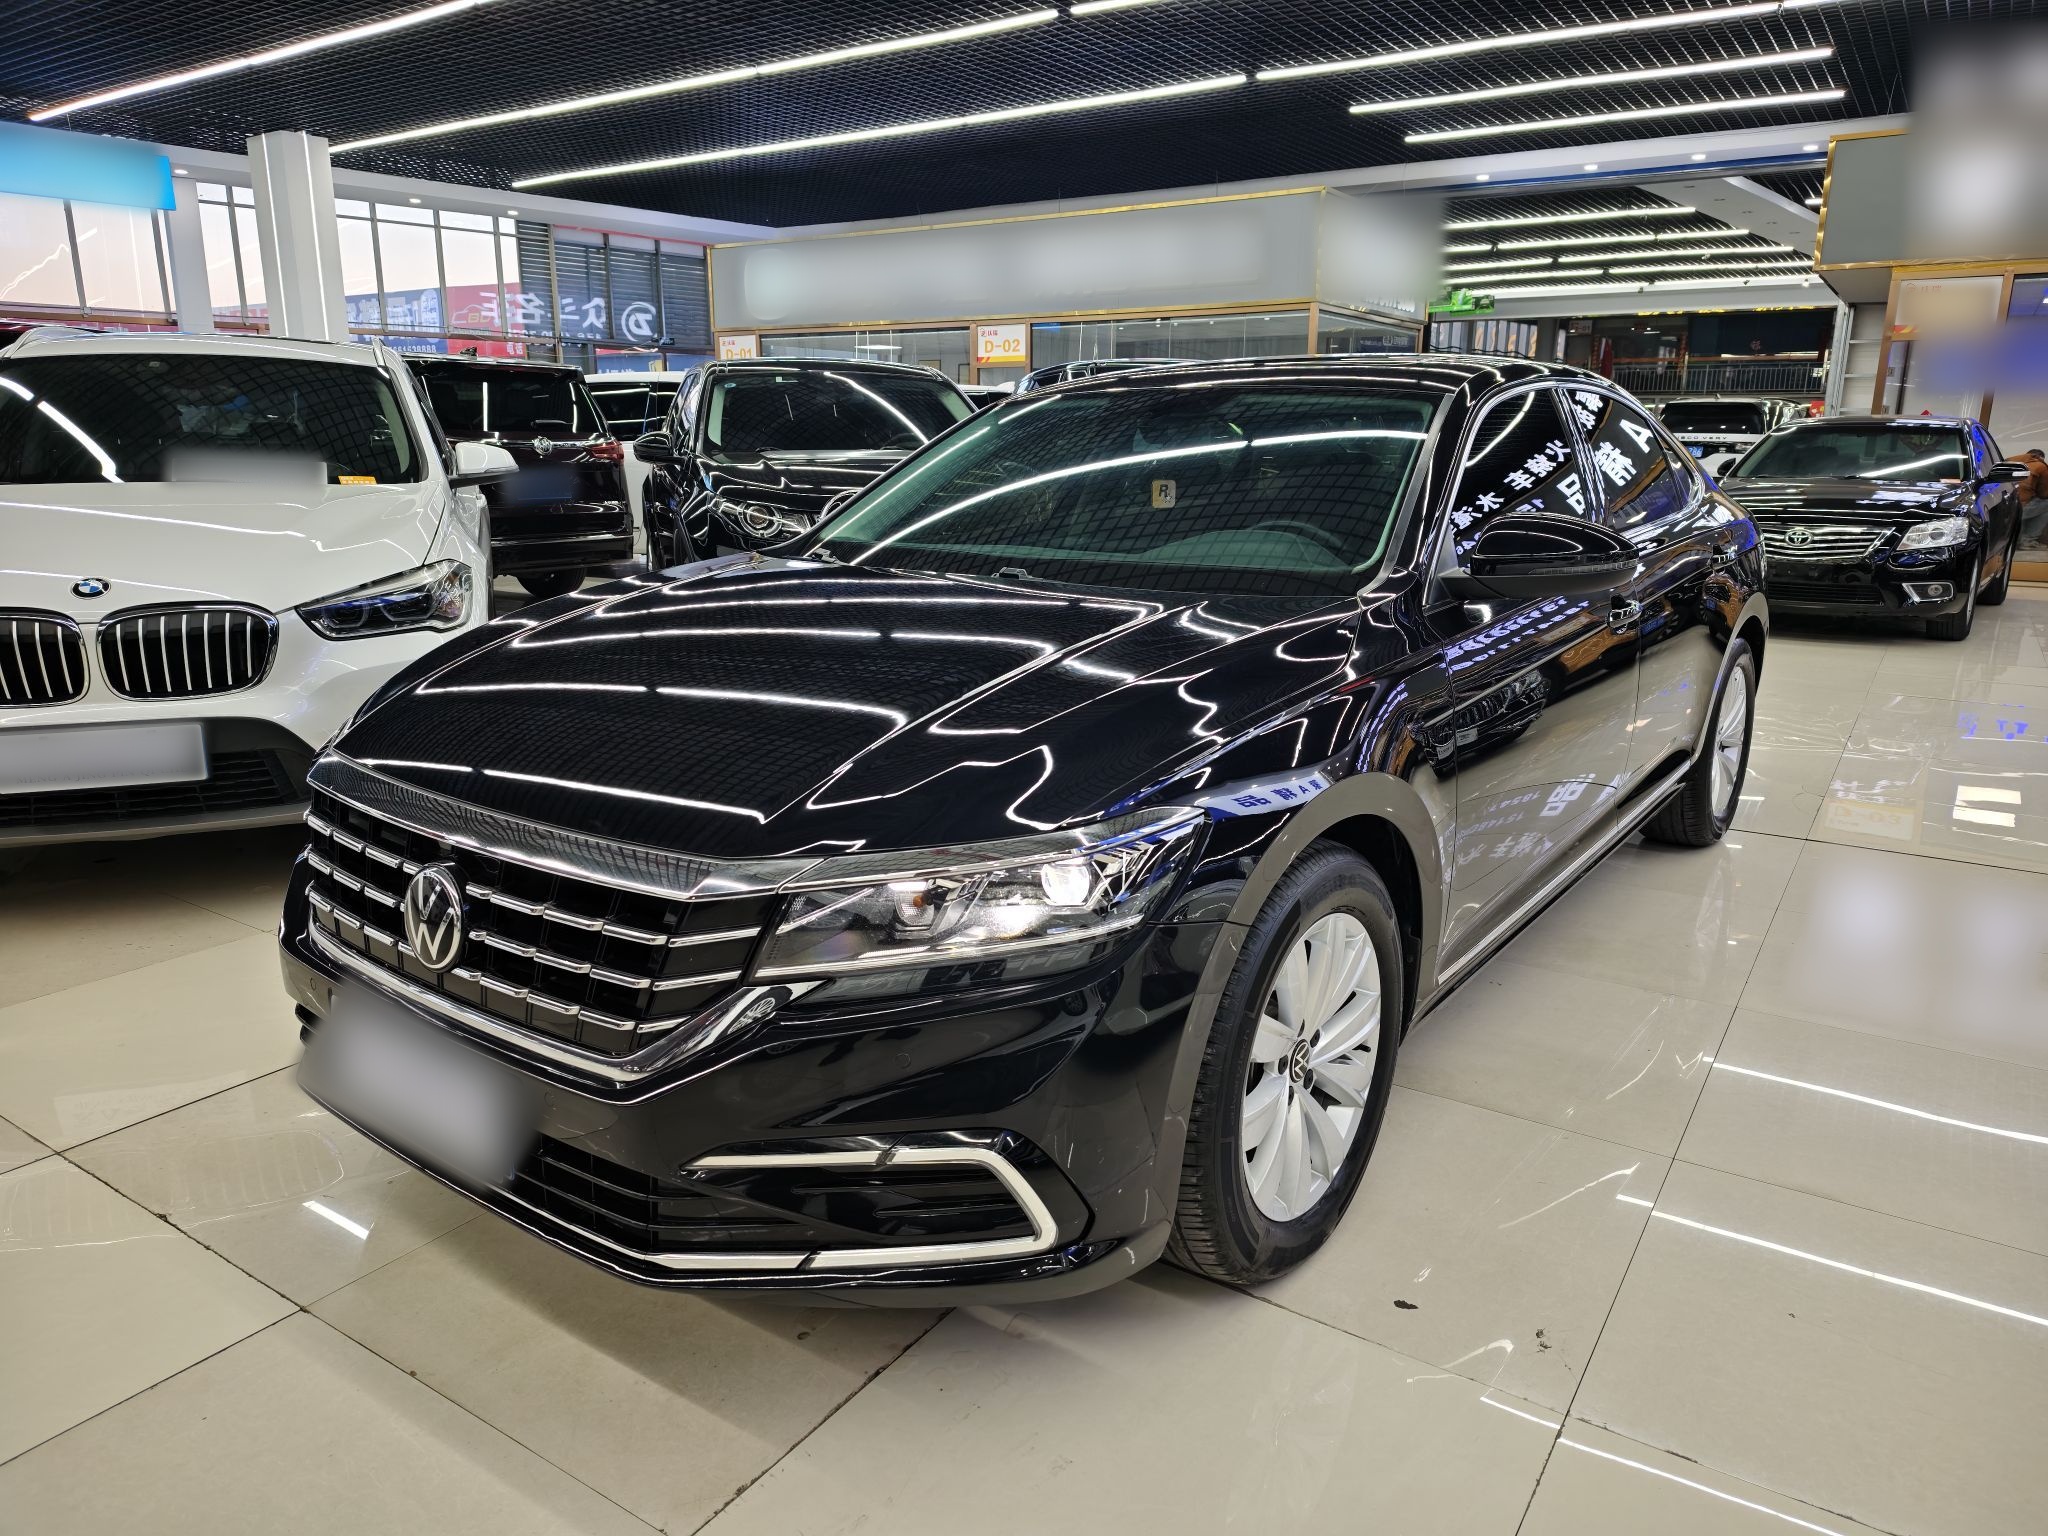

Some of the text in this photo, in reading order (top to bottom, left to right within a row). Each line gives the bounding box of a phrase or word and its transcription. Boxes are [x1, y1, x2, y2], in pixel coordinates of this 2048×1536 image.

[984, 339, 1021, 353] D-02
[725, 348, 753, 360] D-01
[16, 774, 57, 784] MENG
[75, 771, 107, 782] JING
